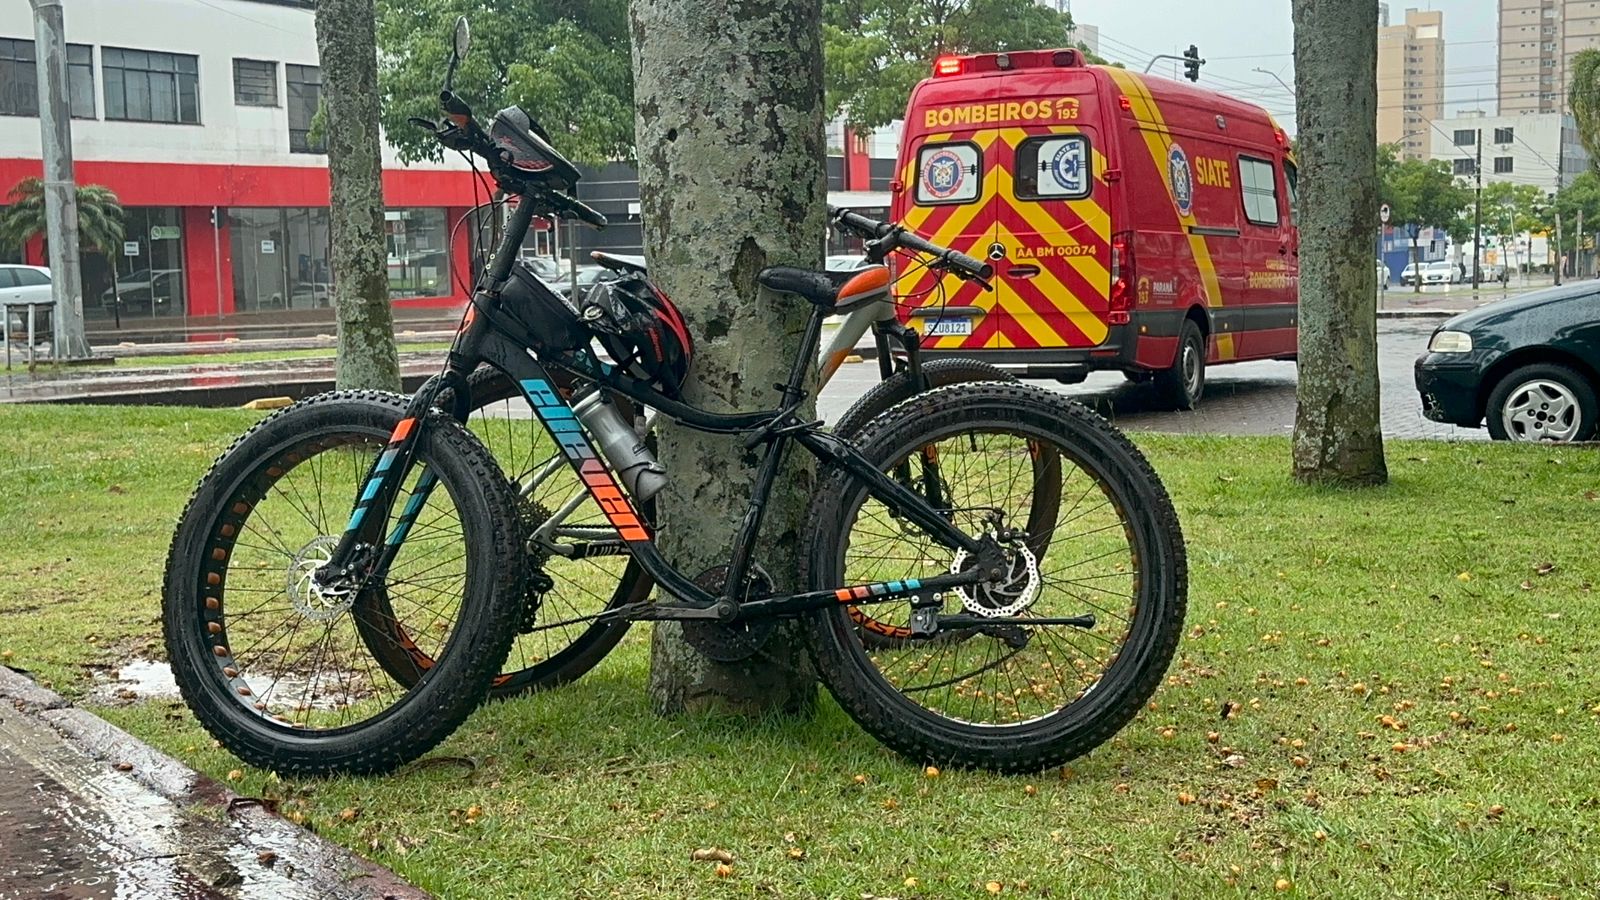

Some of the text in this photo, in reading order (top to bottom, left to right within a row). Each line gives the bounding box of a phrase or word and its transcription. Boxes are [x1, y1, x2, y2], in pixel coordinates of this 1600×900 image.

[925, 100, 1052, 128] BOMBEIROS
[1056, 108, 1079, 120] 193
[1195, 155, 1231, 188] SIATE
[1017, 244, 1097, 258] AA BM 00074
